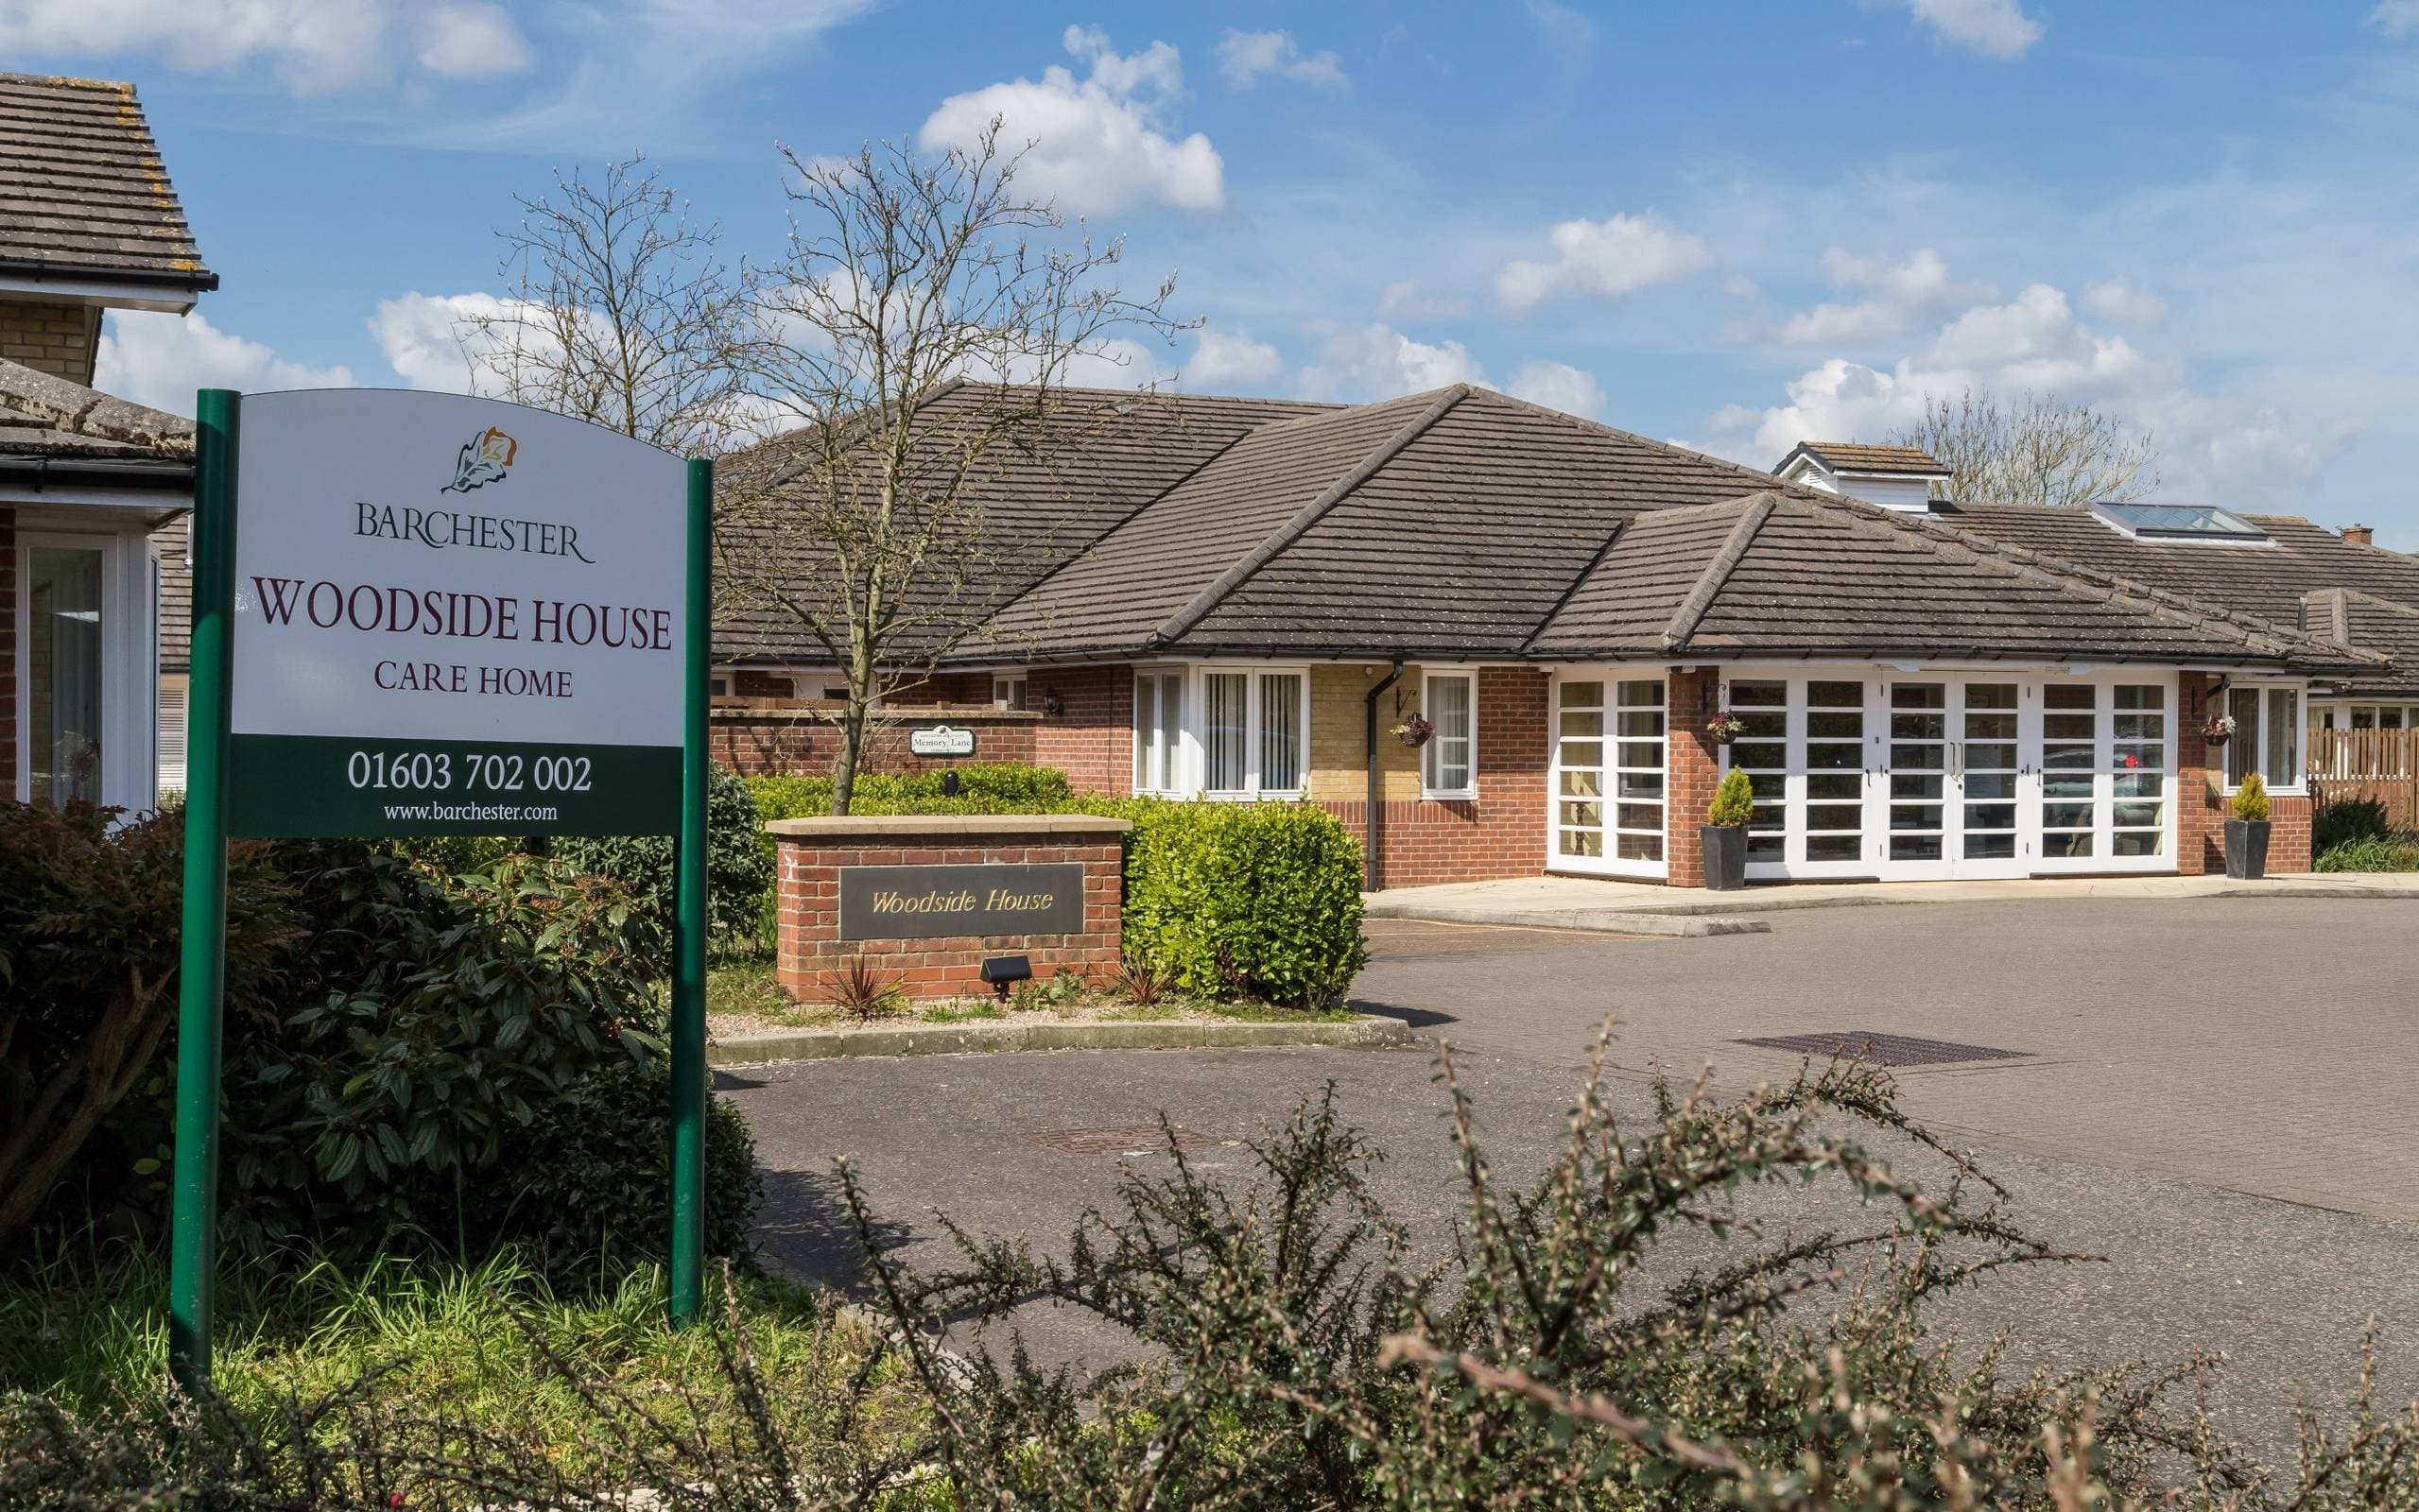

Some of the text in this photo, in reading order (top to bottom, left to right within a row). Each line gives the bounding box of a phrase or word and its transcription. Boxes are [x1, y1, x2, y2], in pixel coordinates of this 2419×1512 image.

[354, 503, 596, 563] BARCHESTER
[251, 576, 672, 650] WOODSIDE HOUSE
[374, 661, 573, 698] CARE HOME
[914, 739, 946, 747] Memory
[348, 751, 592, 792] 01603 702 002
[384, 801, 558, 822] www.barchester.com
[873, 889, 1053, 913] Woodside House
